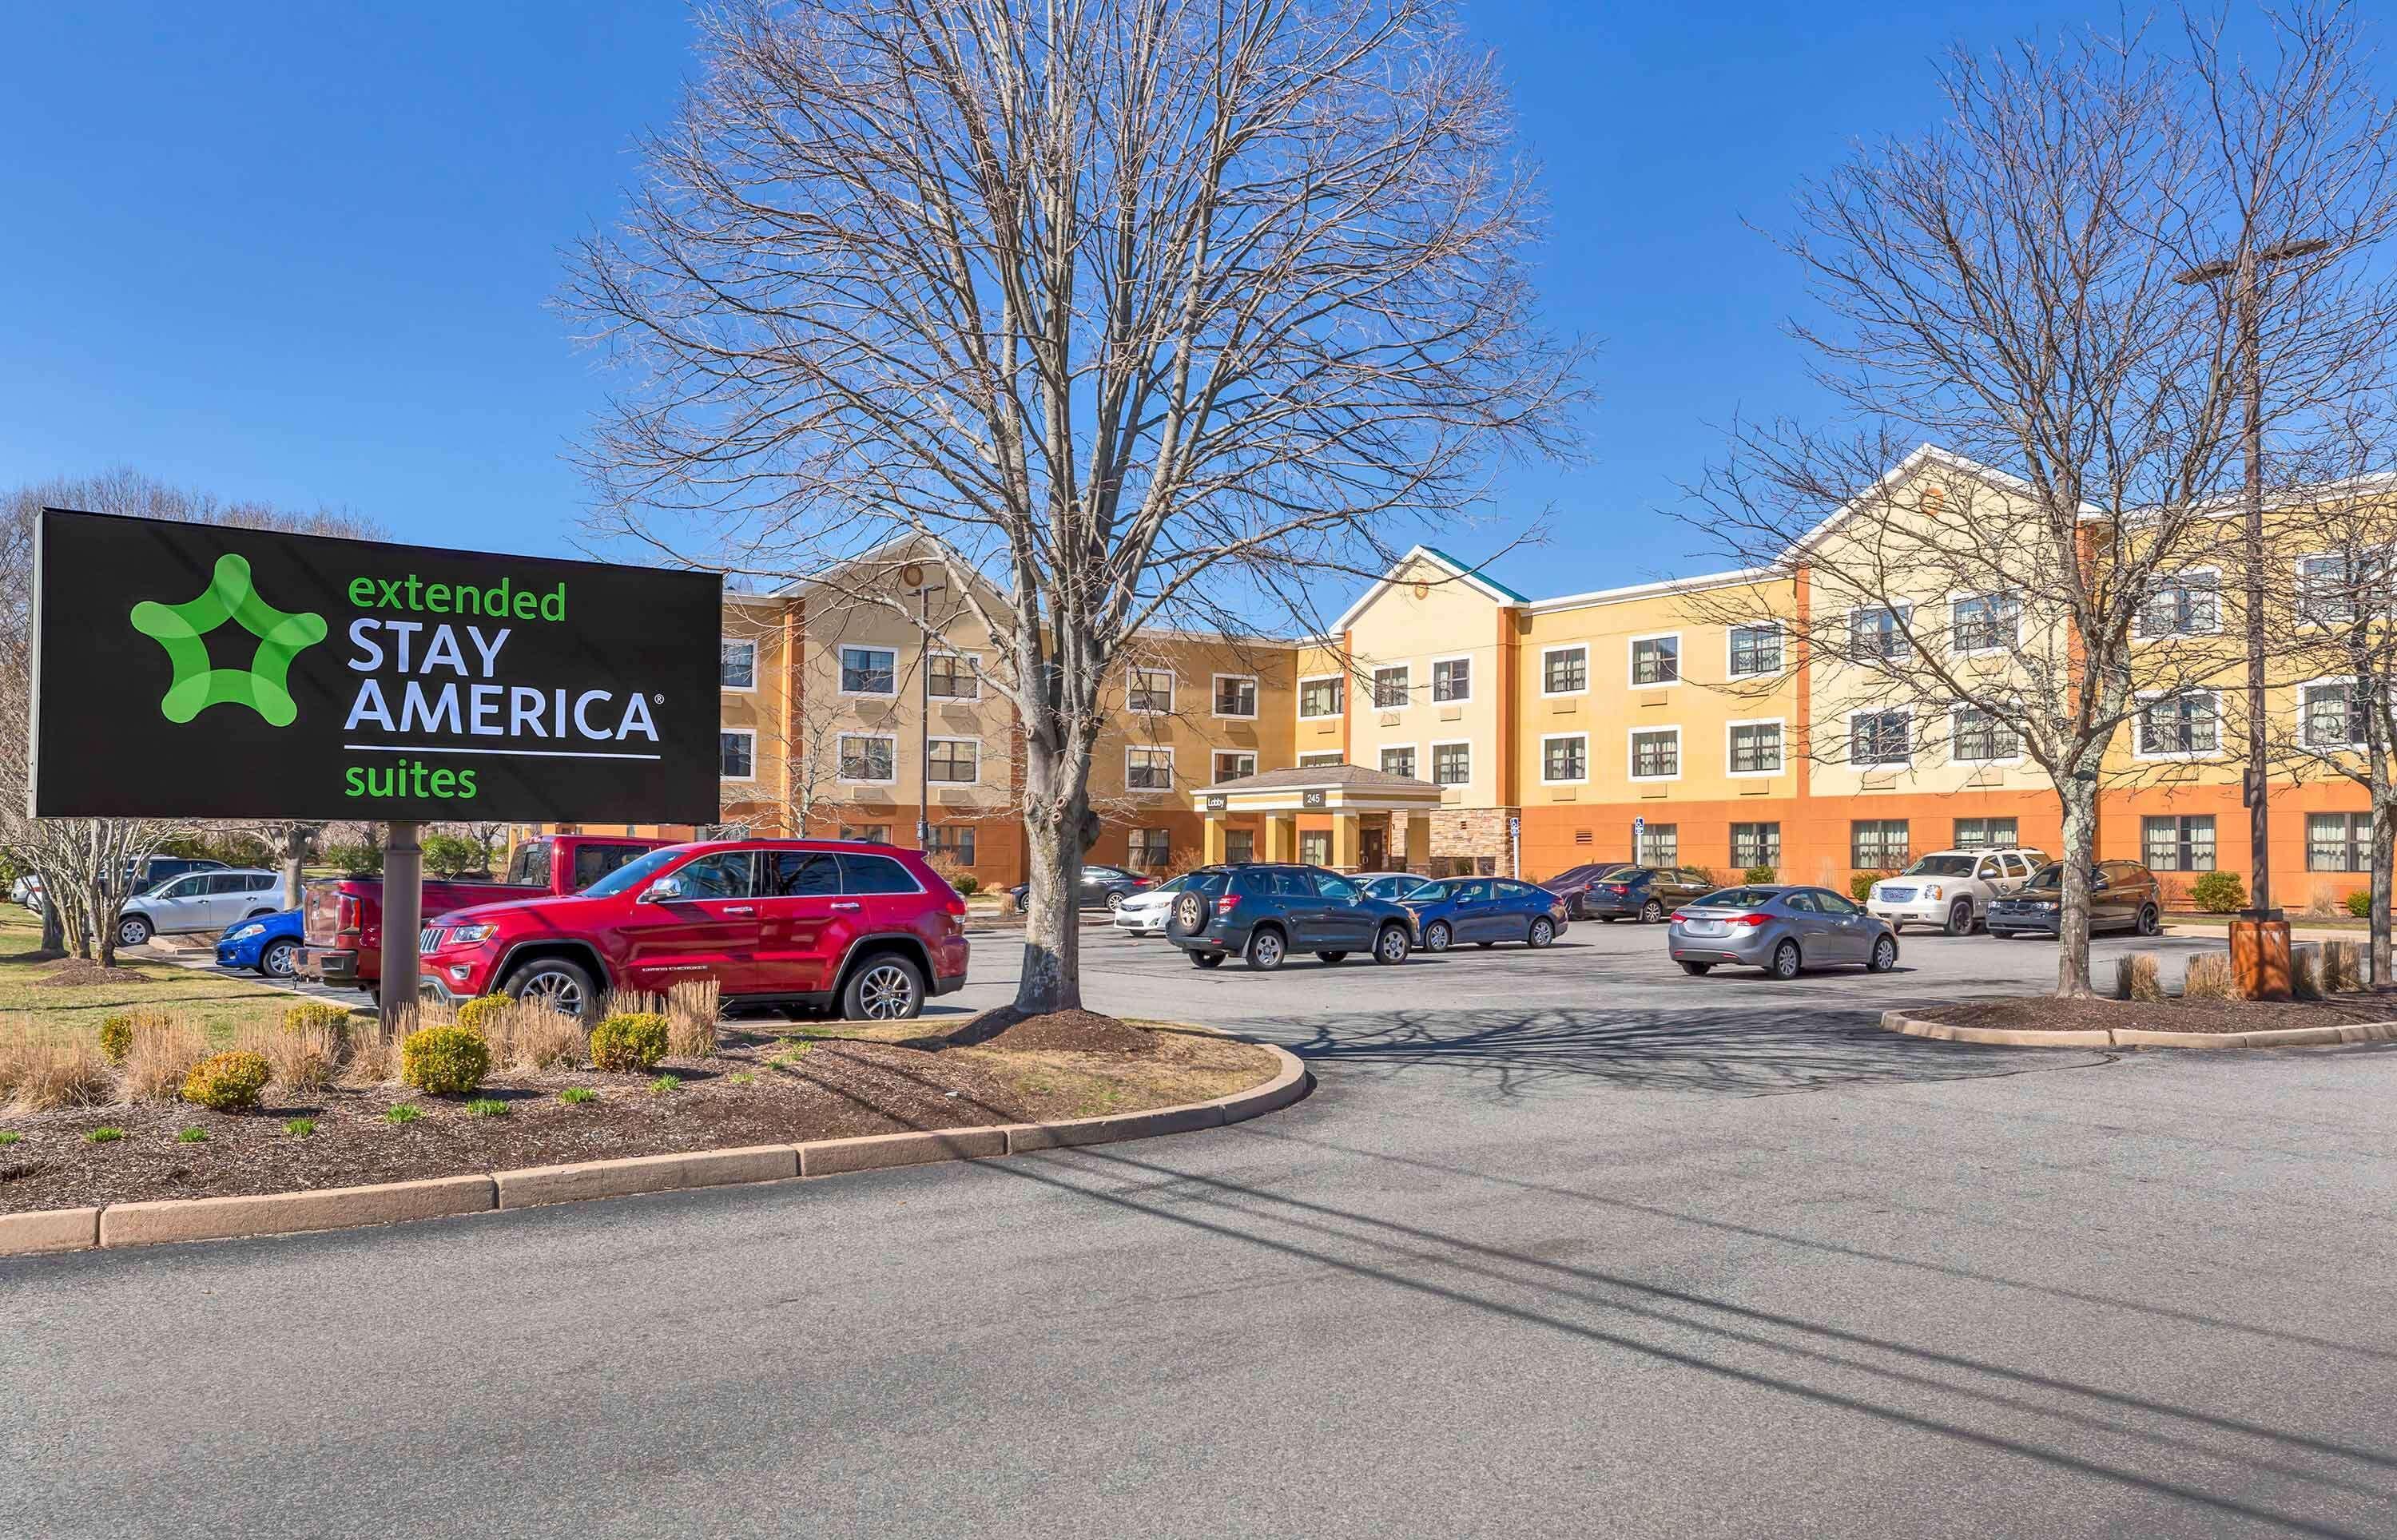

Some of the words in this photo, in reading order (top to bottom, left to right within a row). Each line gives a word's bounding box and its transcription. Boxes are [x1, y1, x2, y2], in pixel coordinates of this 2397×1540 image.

[348, 574, 565, 621] extended
[348, 618, 511, 677] STAY
[345, 759, 477, 798] suites
[1207, 797, 1225, 808] Lobby
[1306, 794, 1321, 804] 245
